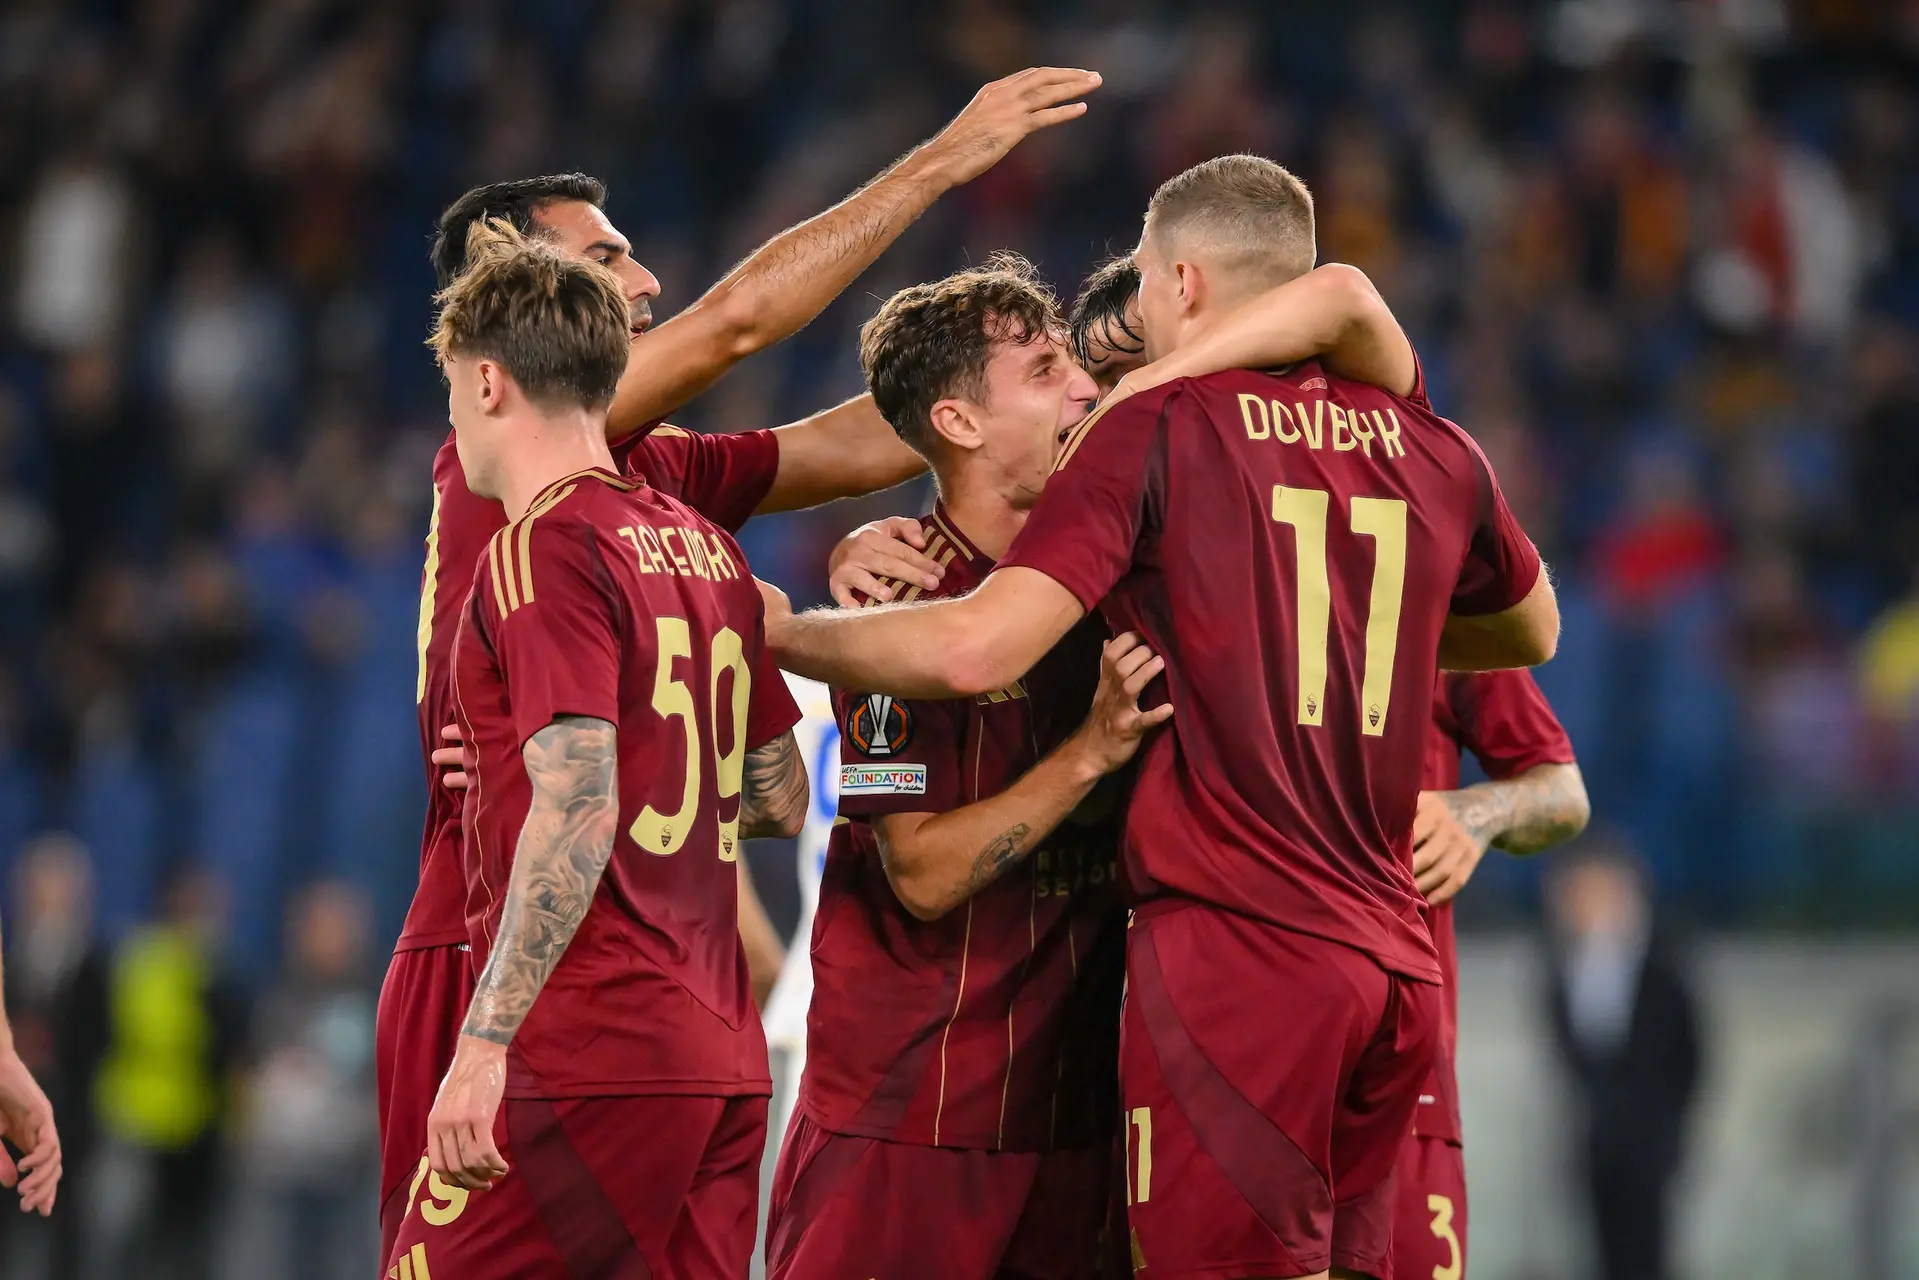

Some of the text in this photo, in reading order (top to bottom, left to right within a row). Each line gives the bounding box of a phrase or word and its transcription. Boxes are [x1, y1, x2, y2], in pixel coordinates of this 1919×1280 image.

[1238, 393, 1406, 458] DOVBYK
[1272, 484, 1407, 737] 11
[629, 616, 751, 863] 59
[894, 784, 902, 792] for
[404, 1155, 470, 1226] 9
[1125, 1106, 1152, 1207] 1
